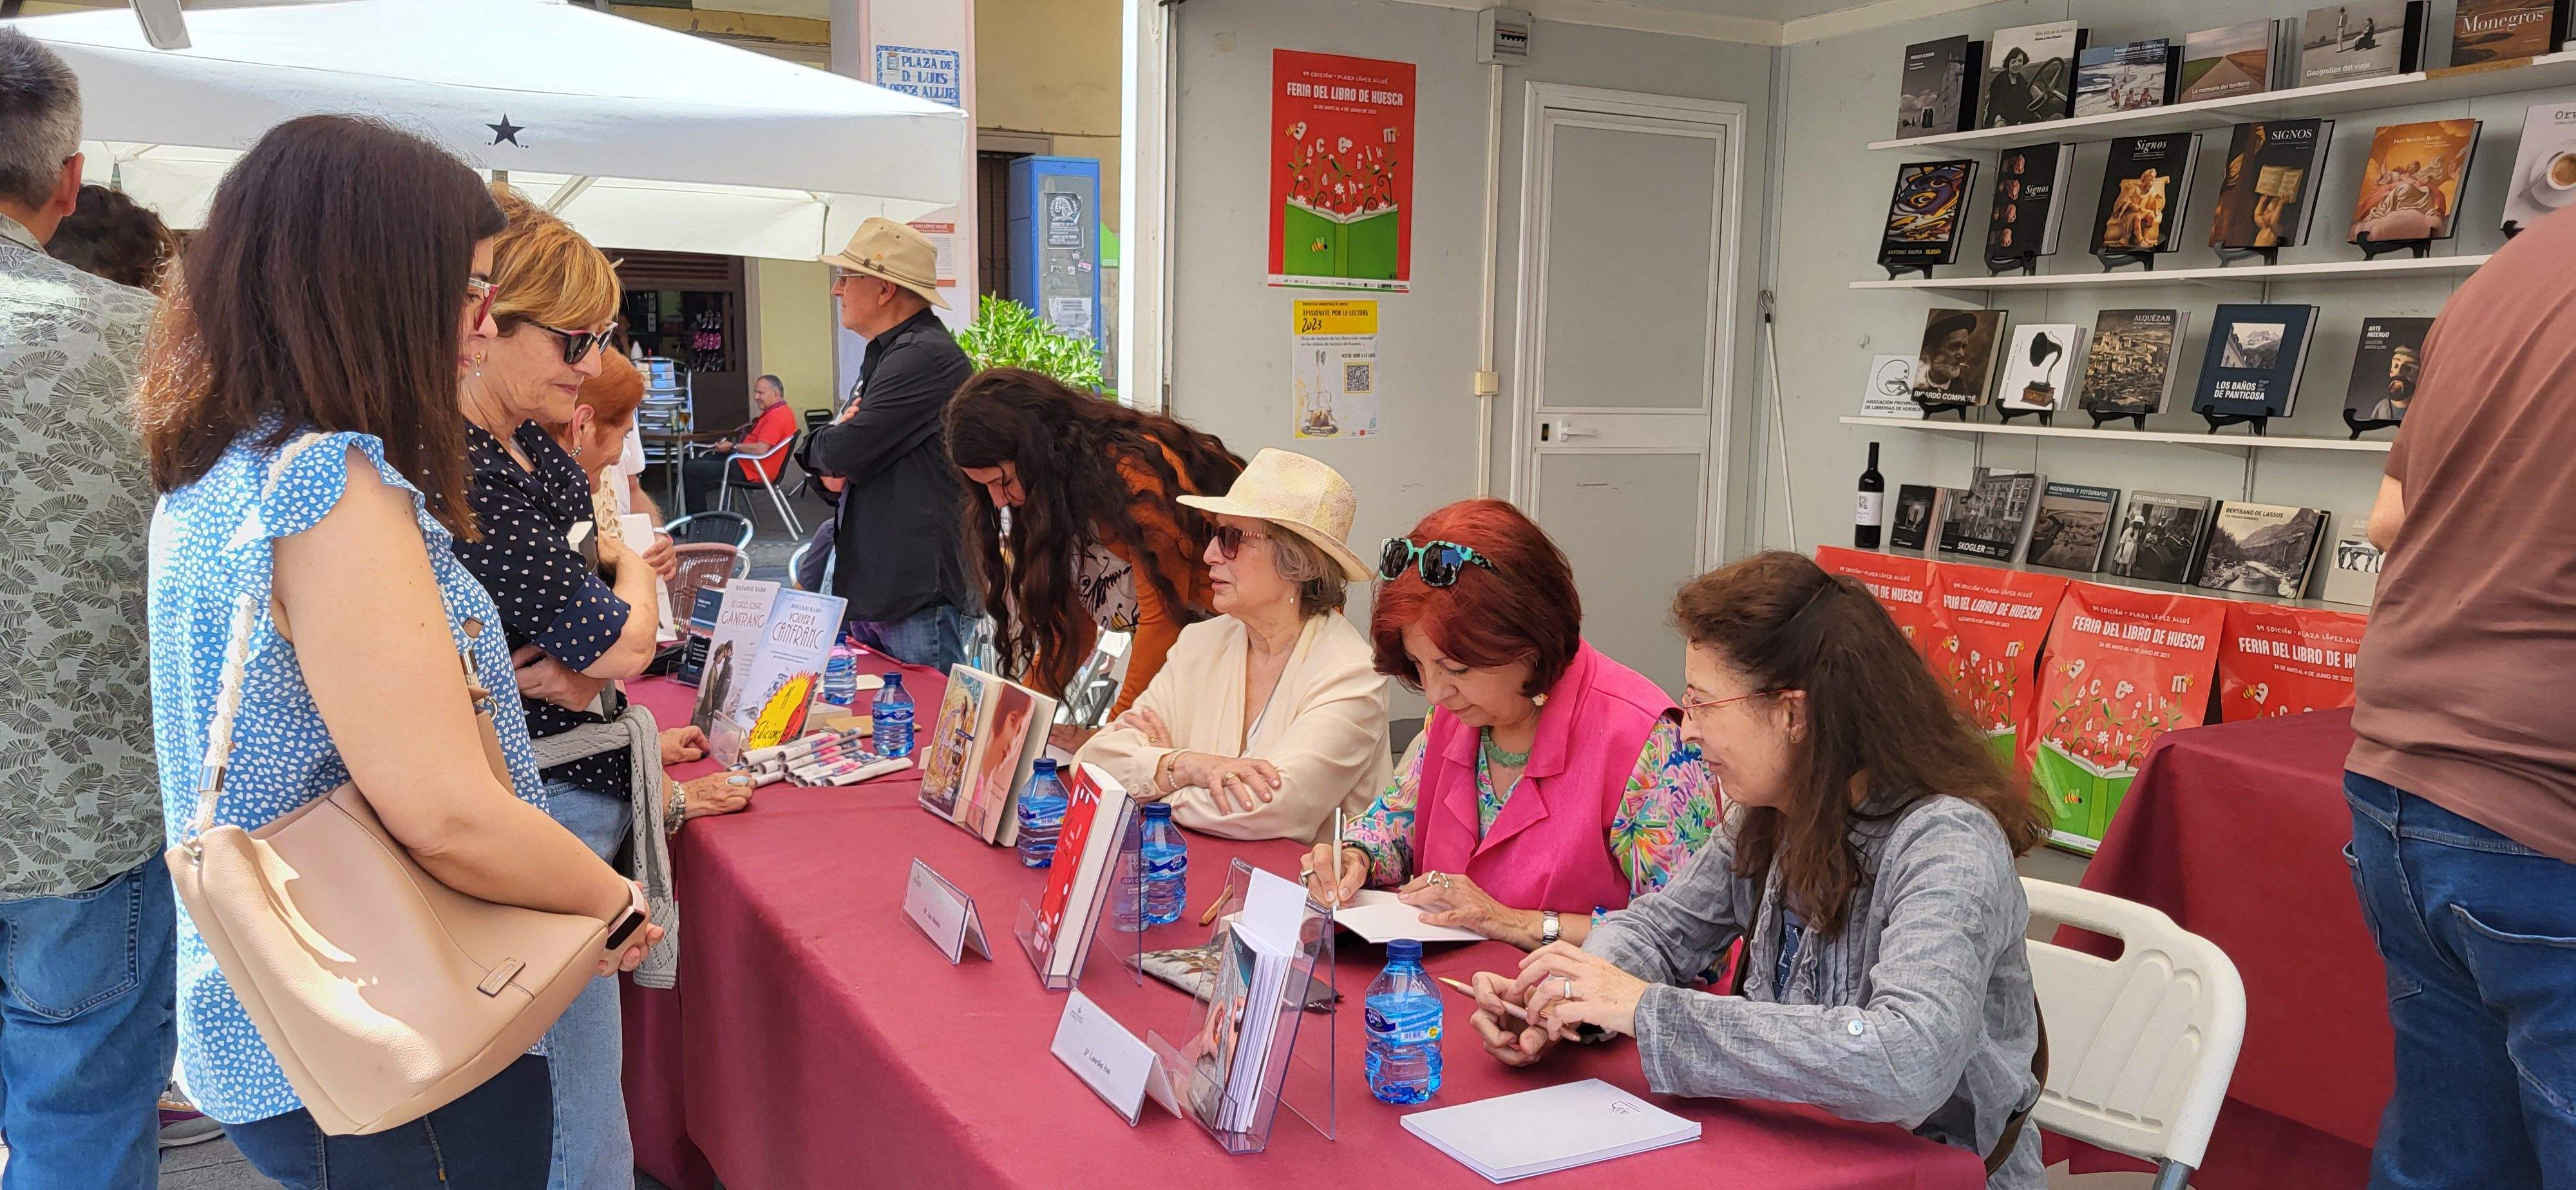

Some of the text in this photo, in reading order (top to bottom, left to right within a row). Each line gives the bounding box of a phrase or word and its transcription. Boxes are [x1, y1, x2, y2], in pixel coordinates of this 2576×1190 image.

[2462, 10, 2544, 33] Monegros
[902, 56, 953, 70] PLAZA DE
[2342, 63, 2353, 71] del
[2354, 62, 2371, 70] viaje
[902, 70, 948, 84] D. LUIS
[1356, 75, 1372, 83] LÓPEZ
[2199, 85, 2220, 93] memoria
[2229, 80, 2250, 88] territorio
[1287, 82, 1403, 107] FERIA DEL LIBRO DE HUESCA
[2271, 129, 2313, 140] SIGNOS
[2135, 139, 2168, 154] Signos
[2025, 184, 2049, 196] Signos
[2134, 313, 2171, 323] ALQUÉZAR
[1302, 317, 1322, 334] 2023
[2216, 381, 2231, 390] LOS
[2231, 381, 2257, 391] BAÑOS
[2213, 390, 2265, 401] DE PANTICOSA
[2049, 485, 2075, 494] INGENIEROS
[2079, 488, 2108, 497] FOTÓGRAFOS
[2133, 494, 2159, 503] FELICIANO
[2226, 507, 2255, 516] BERTRAND
[1957, 542, 1985, 554] SKOGLER
[1880, 585, 1890, 600] DE
[1891, 587, 1924, 605] HUESCA
[2000, 588, 2016, 596] LÓPEZ
[1970, 598, 1998, 614] LIBRO
[1996, 602, 2011, 617] DE
[2008, 605, 2043, 620] HUESCA
[2100, 607, 2123, 616] EDICIÓN
[2151, 612, 2171, 622] LÓPEZ
[721, 611, 765, 628] CANFRANC
[790, 612, 811, 625] VOLVER
[772, 622, 824, 650] CANFRANC
[2072, 616, 2206, 651] FERIA DEL LIBRO DE HUESCA
[2266, 625, 2292, 635] EDICIÓN
[2297, 630, 2320, 639] PLAZA
[2322, 631, 2344, 643] LÓPEZ
[2239, 637, 2270, 656] FERIA
[2272, 641, 2290, 659] DEL
[2292, 645, 2323, 665] LIBRO
[2326, 650, 2341, 668] DE
